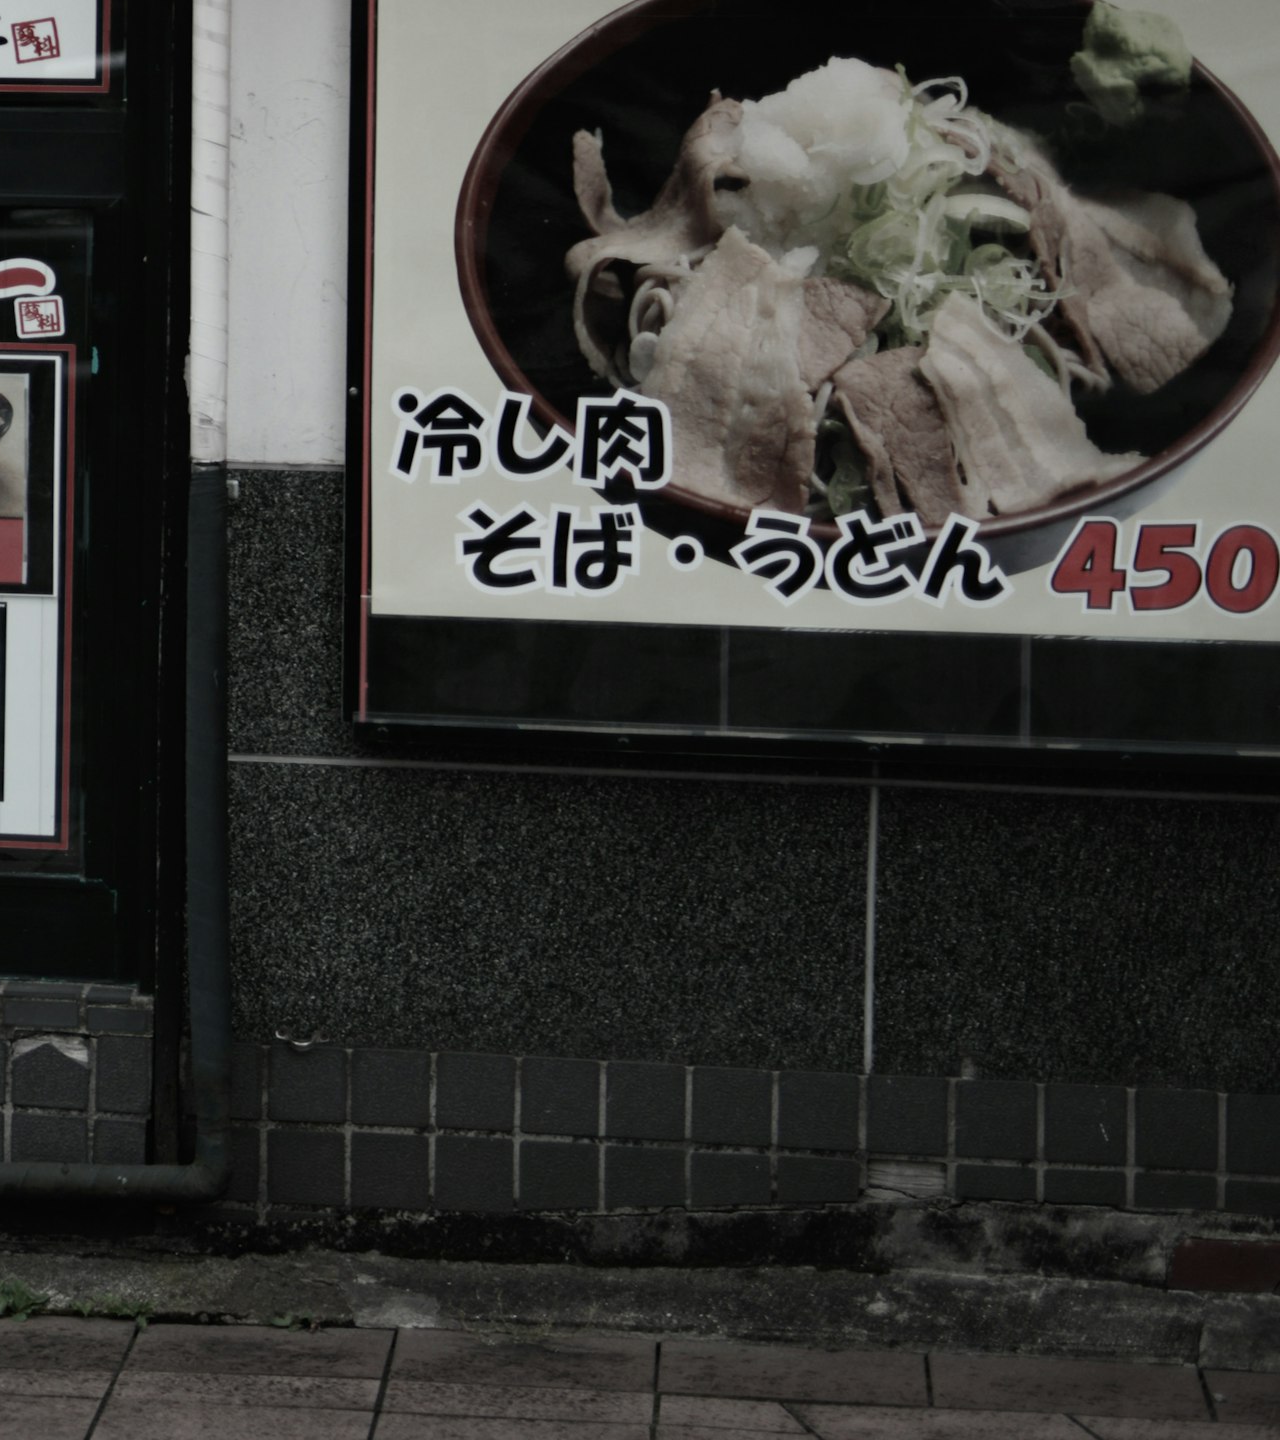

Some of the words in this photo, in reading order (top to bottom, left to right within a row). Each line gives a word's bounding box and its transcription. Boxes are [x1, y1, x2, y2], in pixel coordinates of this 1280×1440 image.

[395, 390, 667, 485] 冷し肉
[458, 506, 1008, 605] そば・うどん
[1050, 518, 1280, 616] 450
